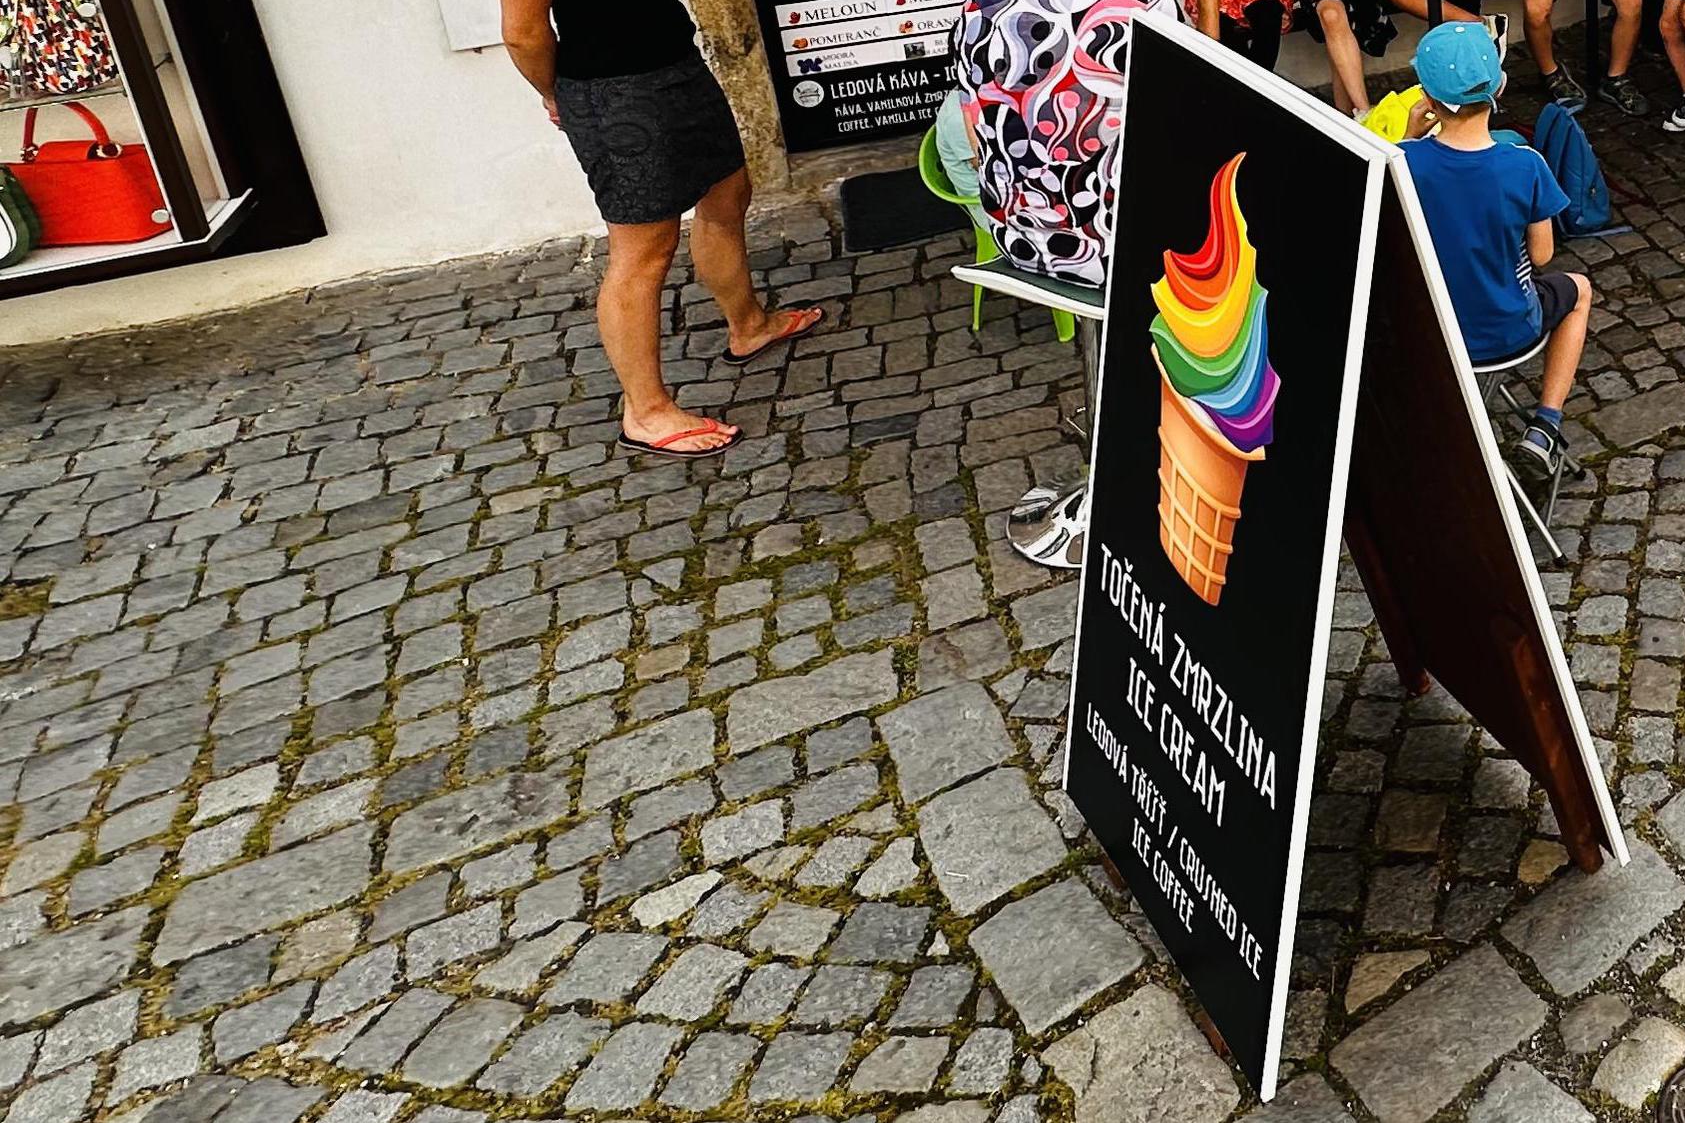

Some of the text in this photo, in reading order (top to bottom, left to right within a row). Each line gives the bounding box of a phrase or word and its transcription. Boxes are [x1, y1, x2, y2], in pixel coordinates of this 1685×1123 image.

[804, 1, 878, 22] MELOUN
[809, 26, 881, 47] POMERANČ
[830, 72, 887, 100] LEDOVÁ
[888, 68, 930, 91] KÁVA
[874, 110, 917, 128] VANILLA
[1101, 542, 1276, 811] TOČENÁ ZMRZLINA
[1126, 656, 1226, 827] ICE CREAM
[1086, 701, 1263, 981] LEDOVÁ TŘÍŠŤ / CRUSHED ICE
[1131, 817, 1195, 934] ICE COFFEE
